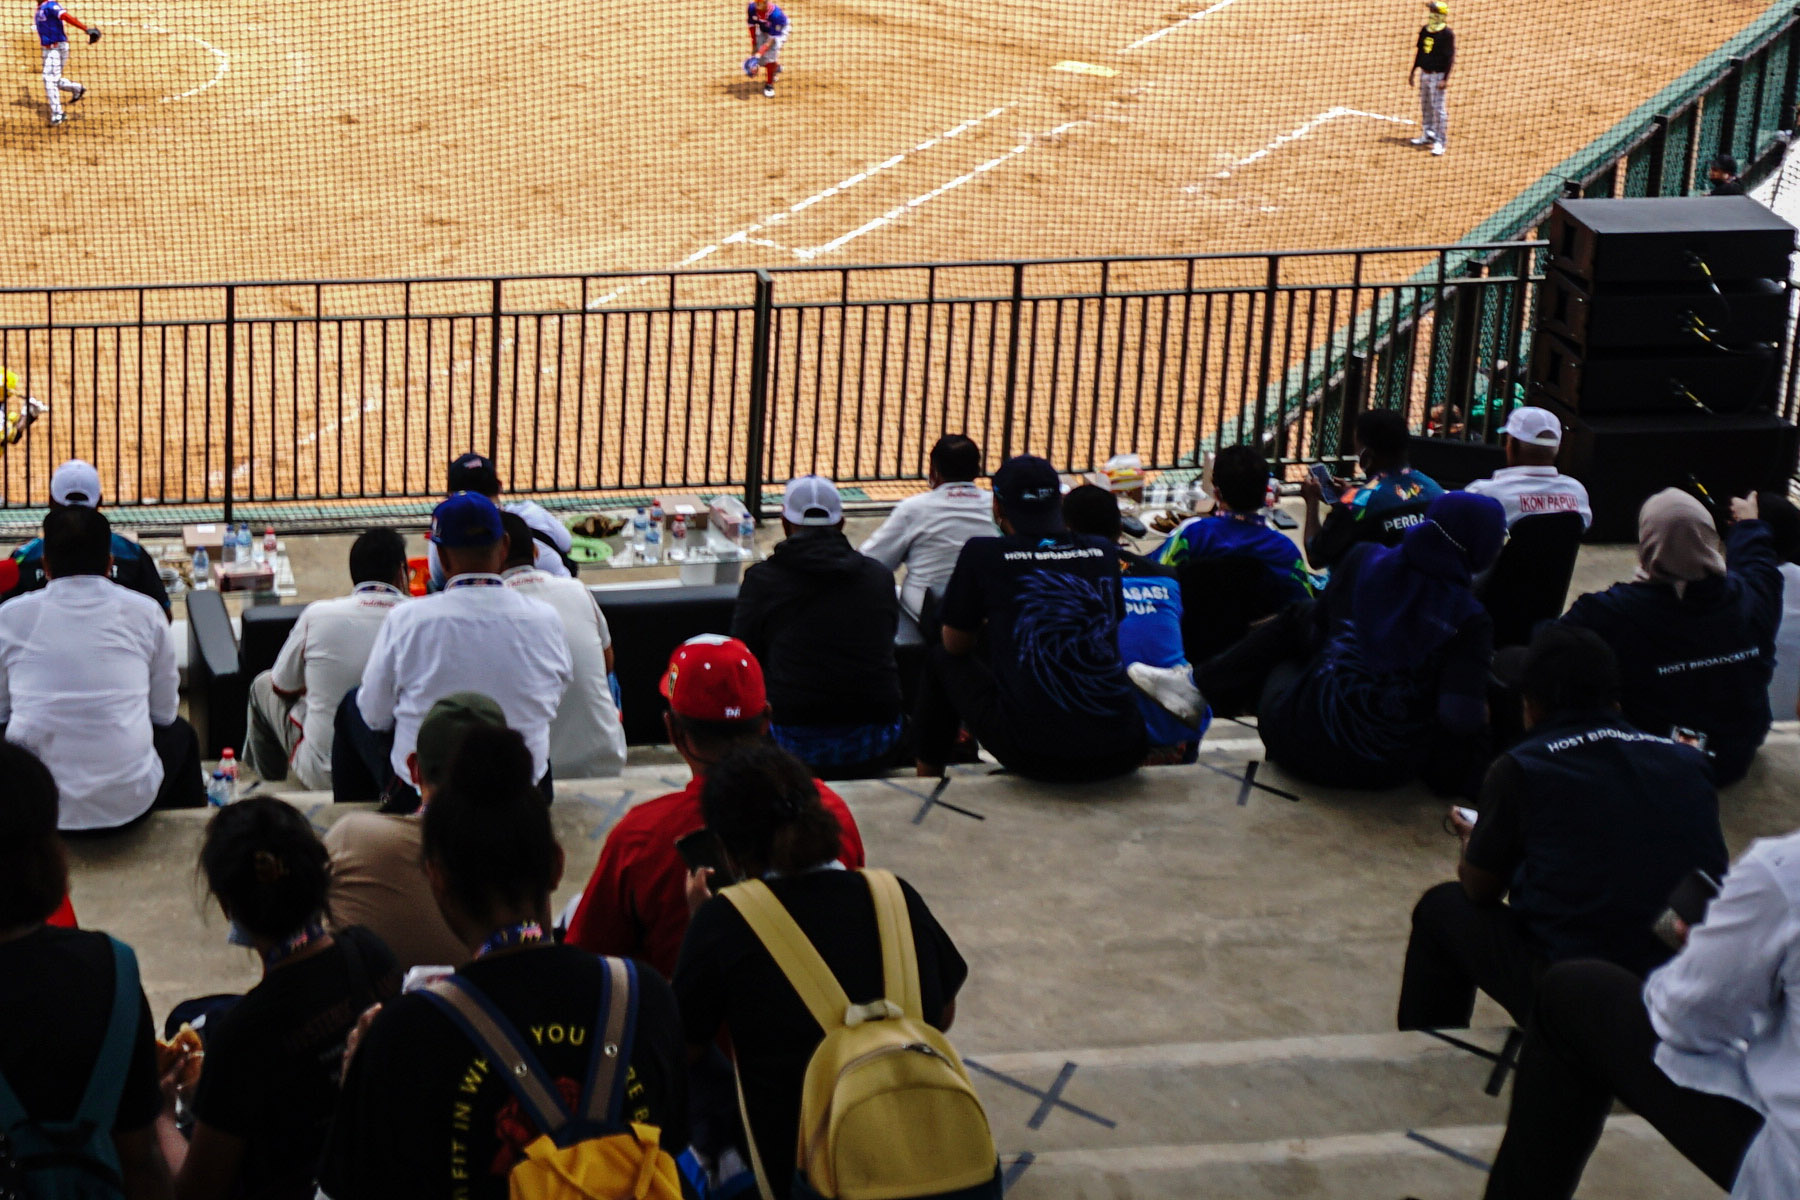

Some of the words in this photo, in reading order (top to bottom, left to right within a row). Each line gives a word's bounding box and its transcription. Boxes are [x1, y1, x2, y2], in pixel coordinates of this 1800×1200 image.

[1547, 495, 1578, 510] PAPUA
[1384, 513, 1426, 533] PERBA
[1004, 551, 1033, 561] HOST
[1122, 585, 1170, 601] ASASI
[1125, 600, 1157, 615] PUA
[1658, 662, 1687, 676] HOST
[1547, 735, 1586, 753] HOST
[454, 1101, 473, 1131] IN
[530, 1023, 587, 1046] YOU
